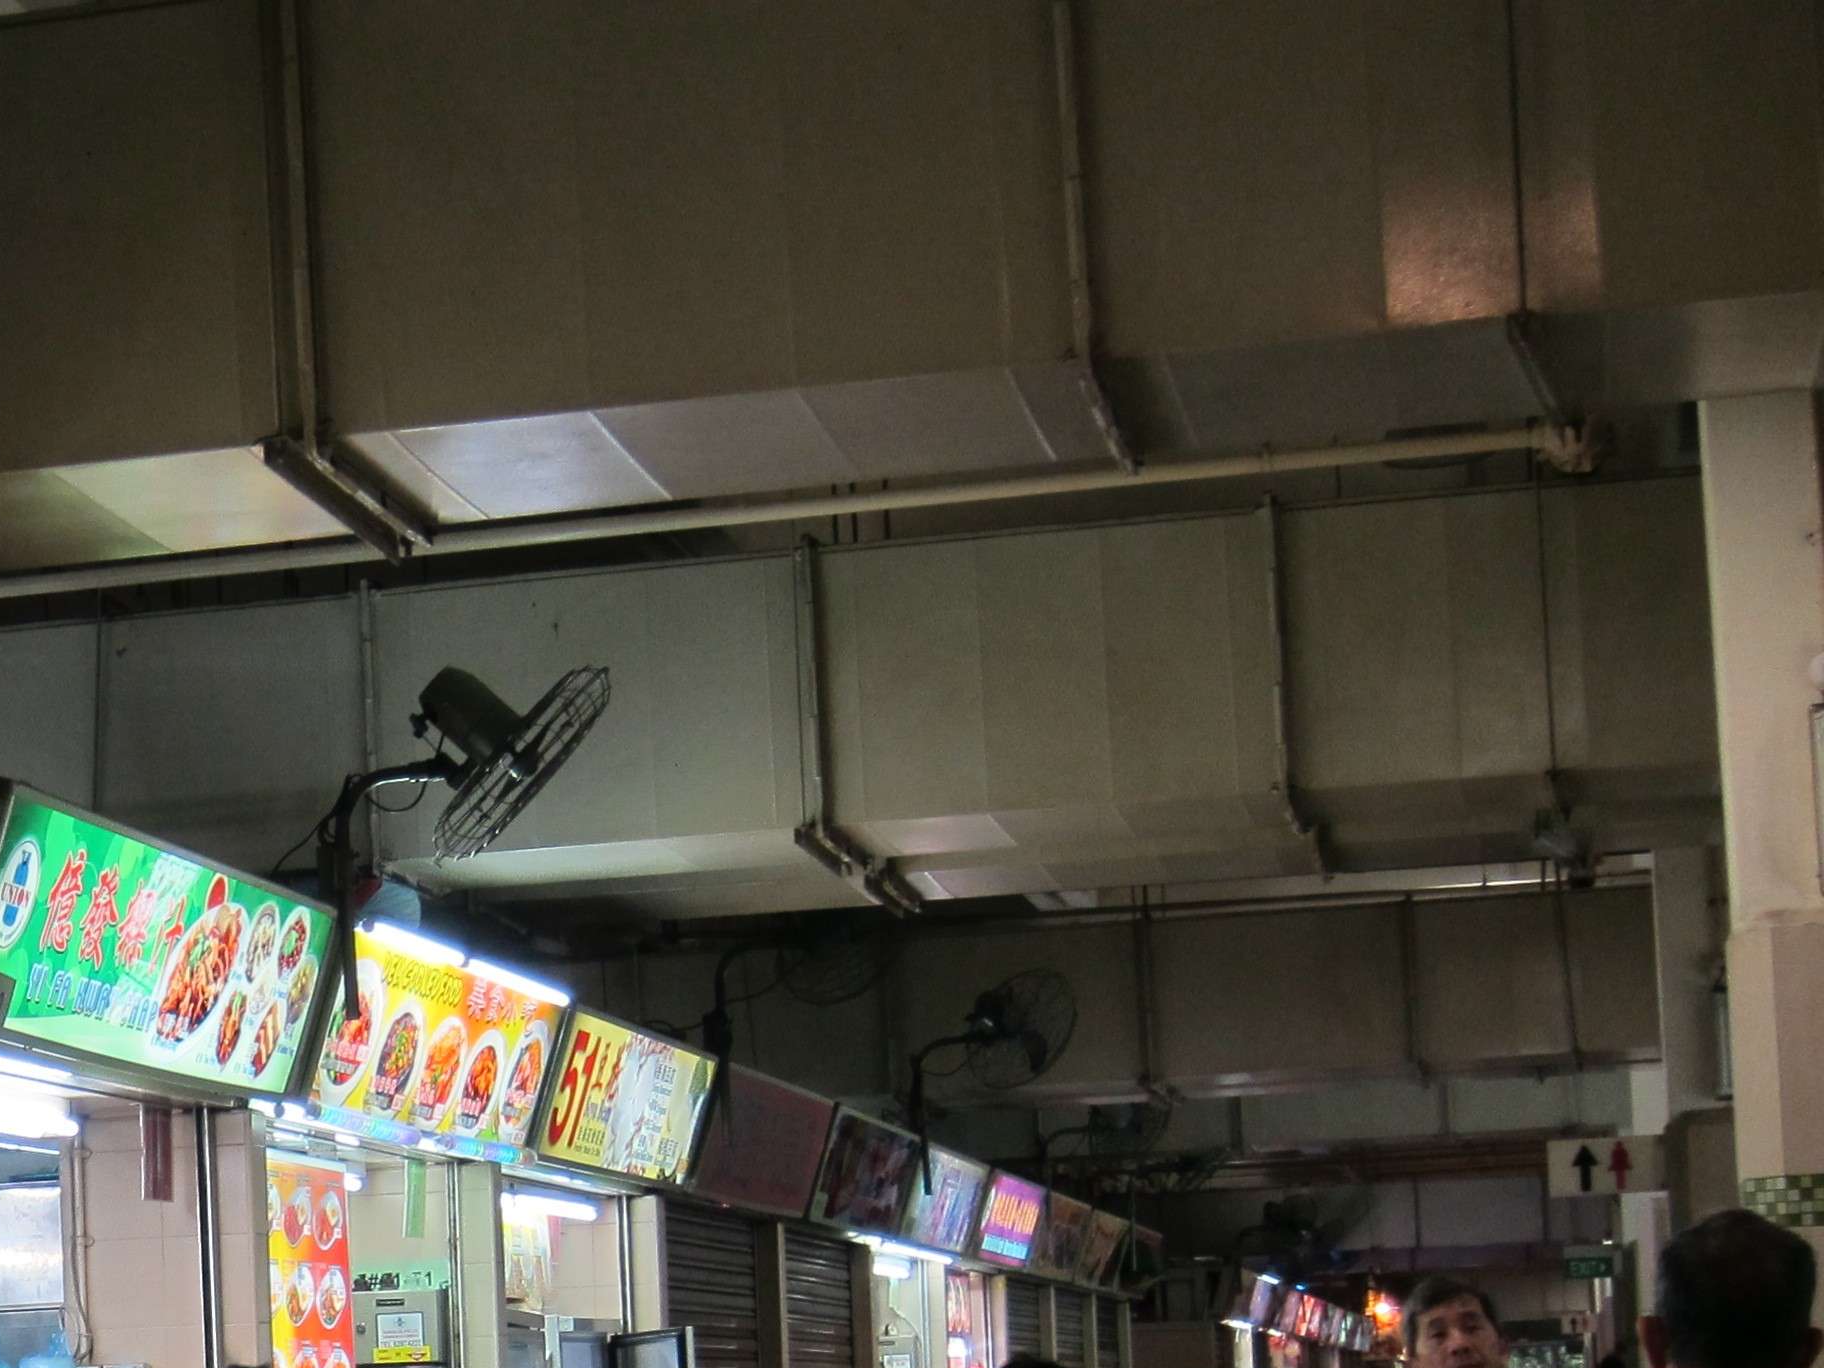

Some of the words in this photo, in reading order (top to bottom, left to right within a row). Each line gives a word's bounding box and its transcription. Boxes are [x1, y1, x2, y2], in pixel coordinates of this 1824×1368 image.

[0, 881, 32, 908] UNION
[27, 962, 49, 1004] YI
[47, 969, 73, 1010] FA
[72, 976, 118, 1023] KWA
[119, 990, 160, 1032] HAP
